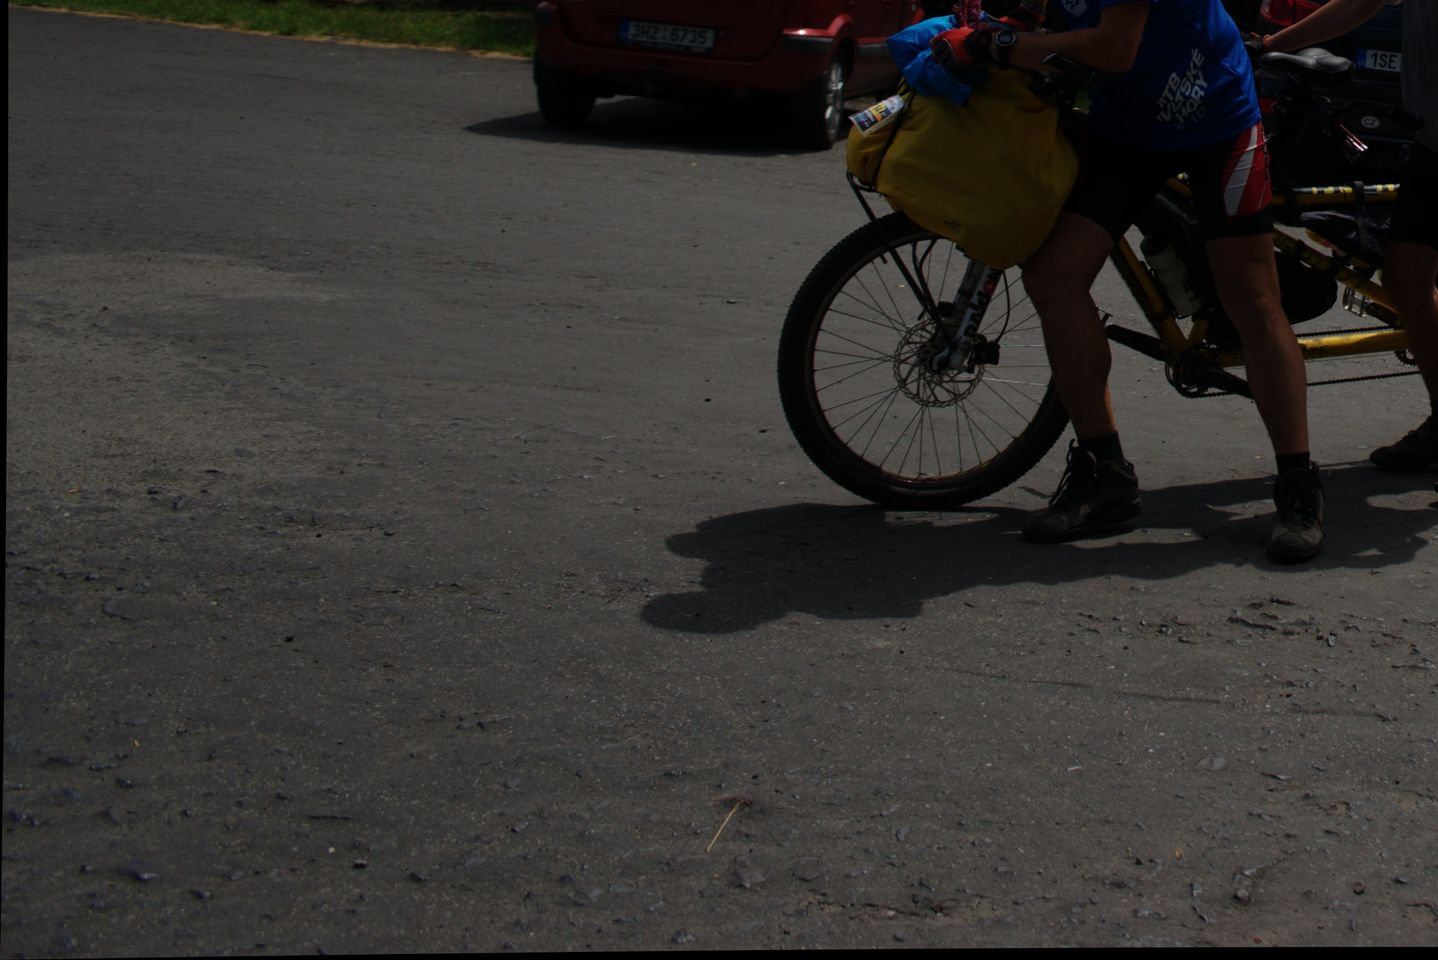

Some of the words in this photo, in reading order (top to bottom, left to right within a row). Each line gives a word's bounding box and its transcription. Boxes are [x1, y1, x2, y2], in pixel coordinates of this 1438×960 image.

[631, 24, 658, 41] 3H2
[670, 27, 707, 45] 6735
[1370, 52, 1397, 70] 1SE
